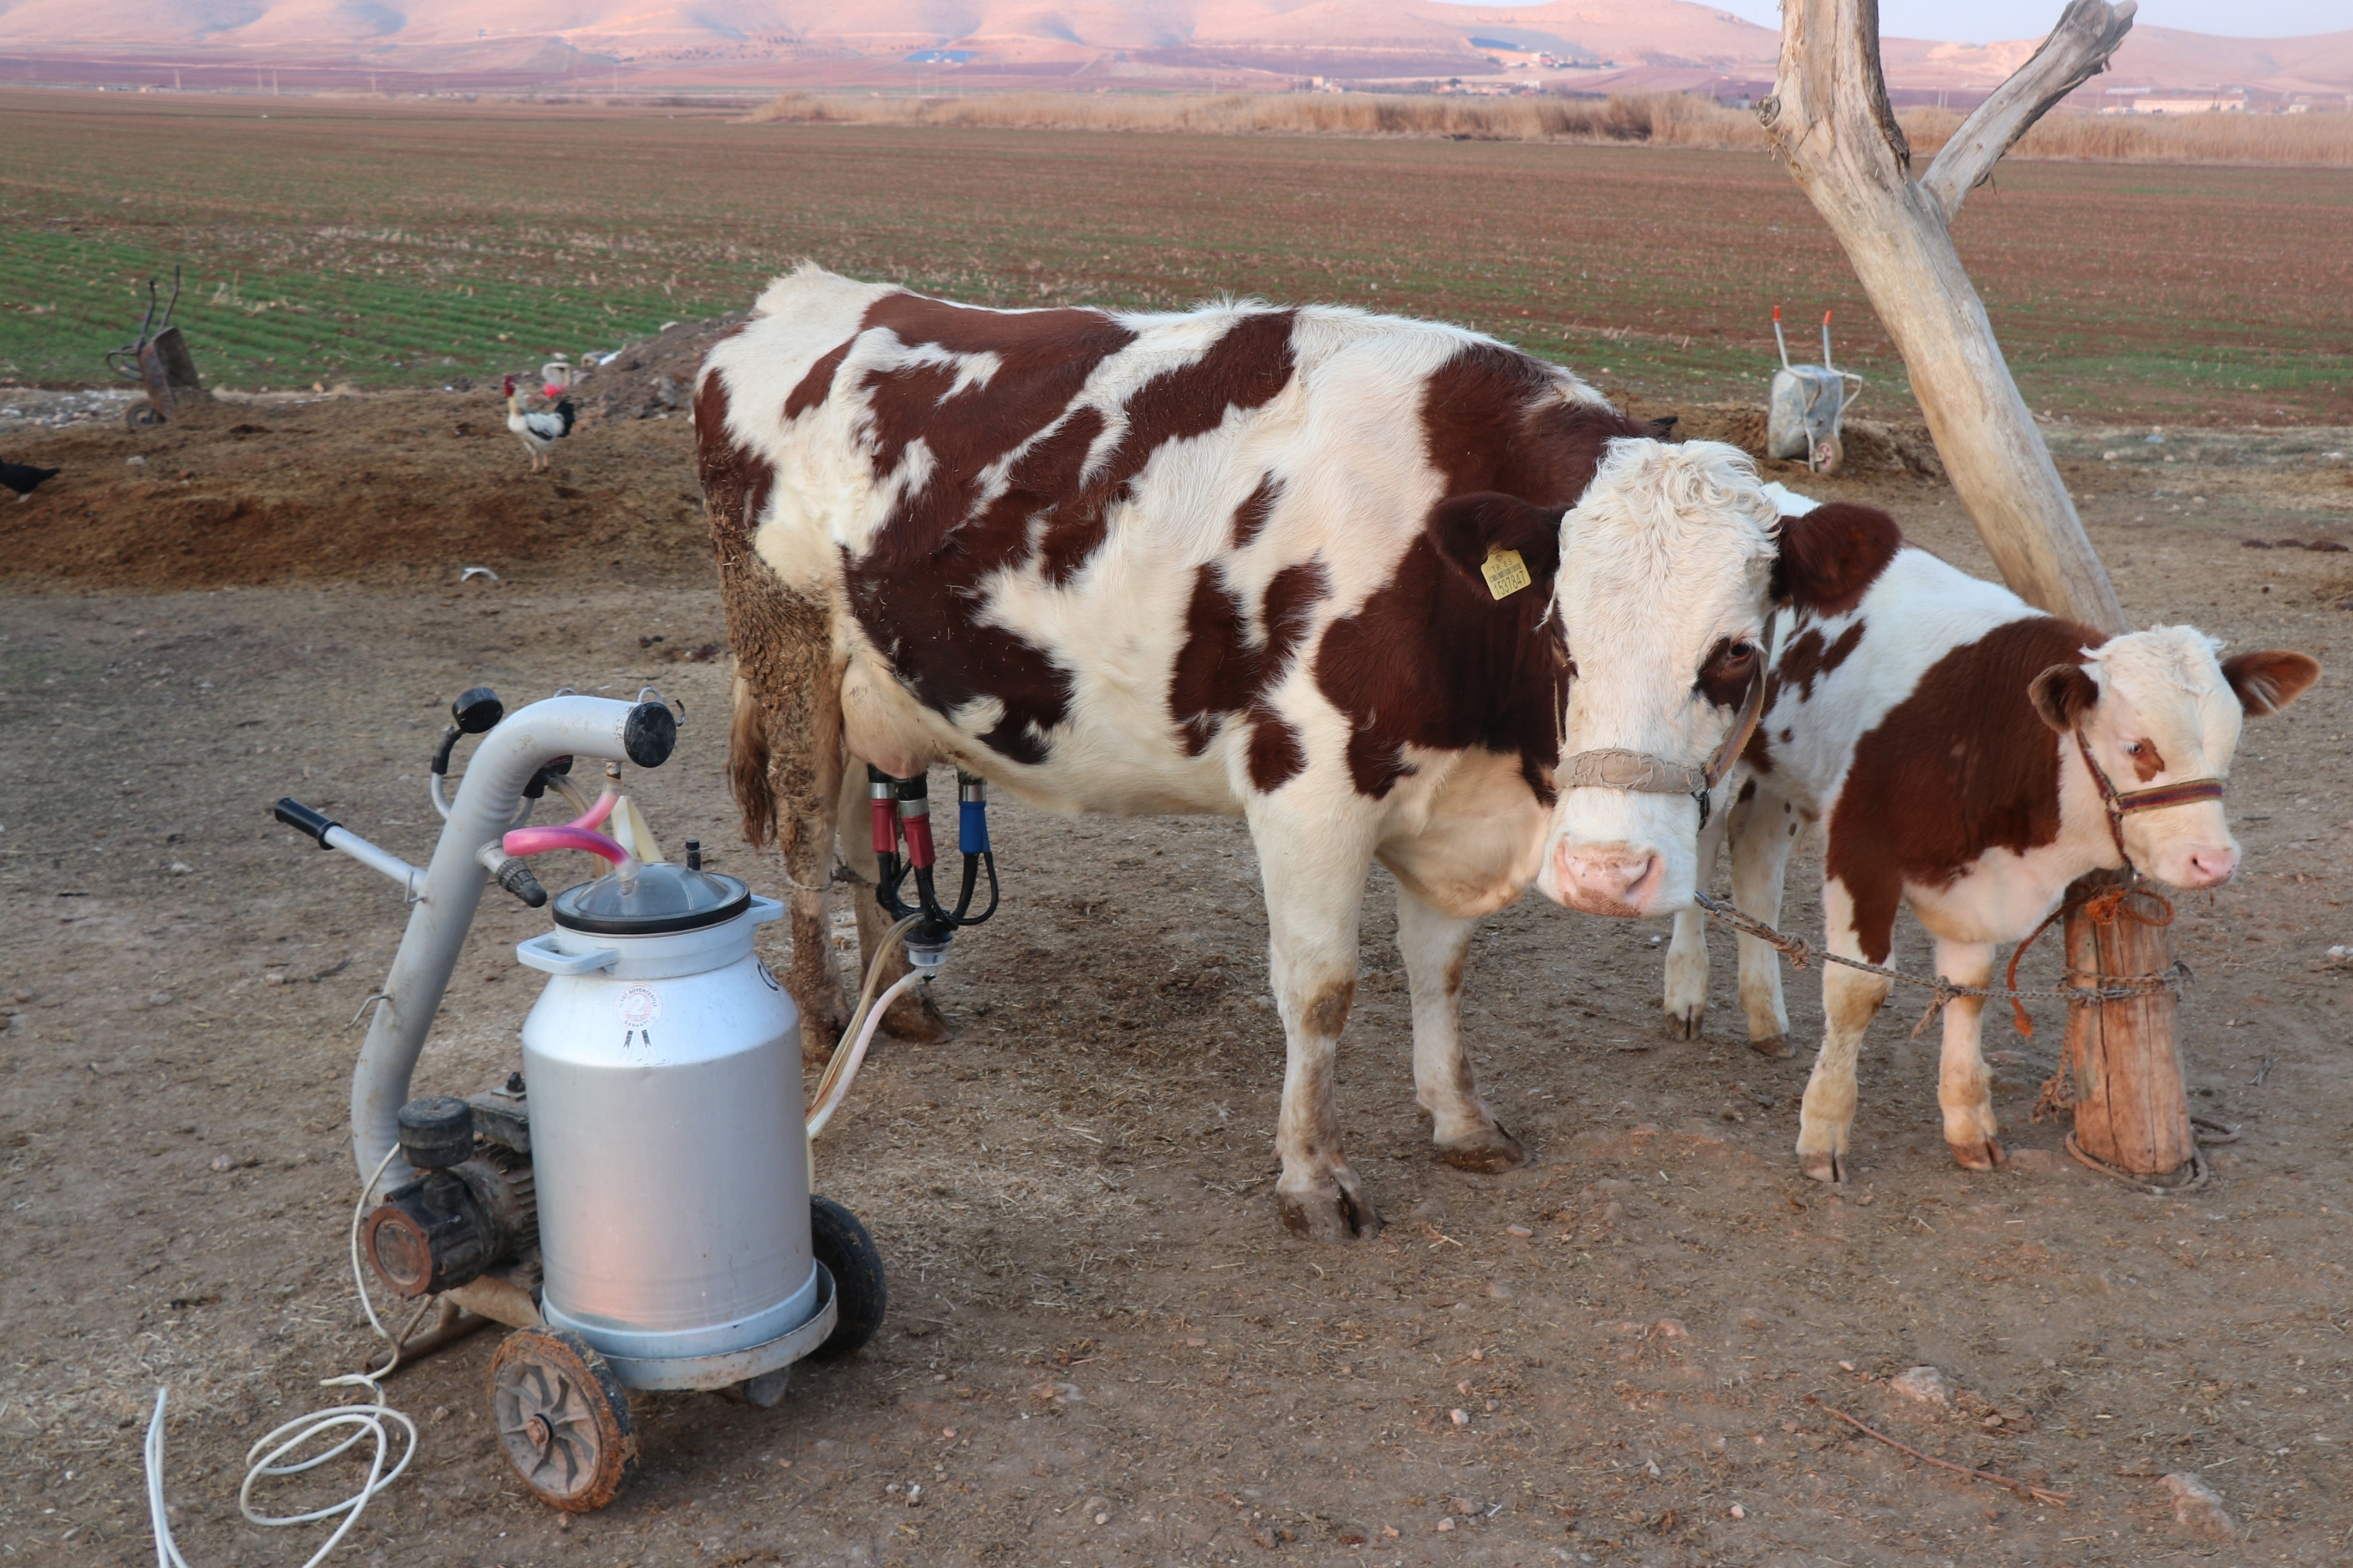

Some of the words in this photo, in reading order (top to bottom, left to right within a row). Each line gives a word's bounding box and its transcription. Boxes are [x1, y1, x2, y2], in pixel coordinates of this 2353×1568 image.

[1491, 564, 1501, 573] TR
[1503, 558, 1513, 567] 63
[1494, 570, 1526, 596] 1537847
[629, 994, 646, 1015] 2
